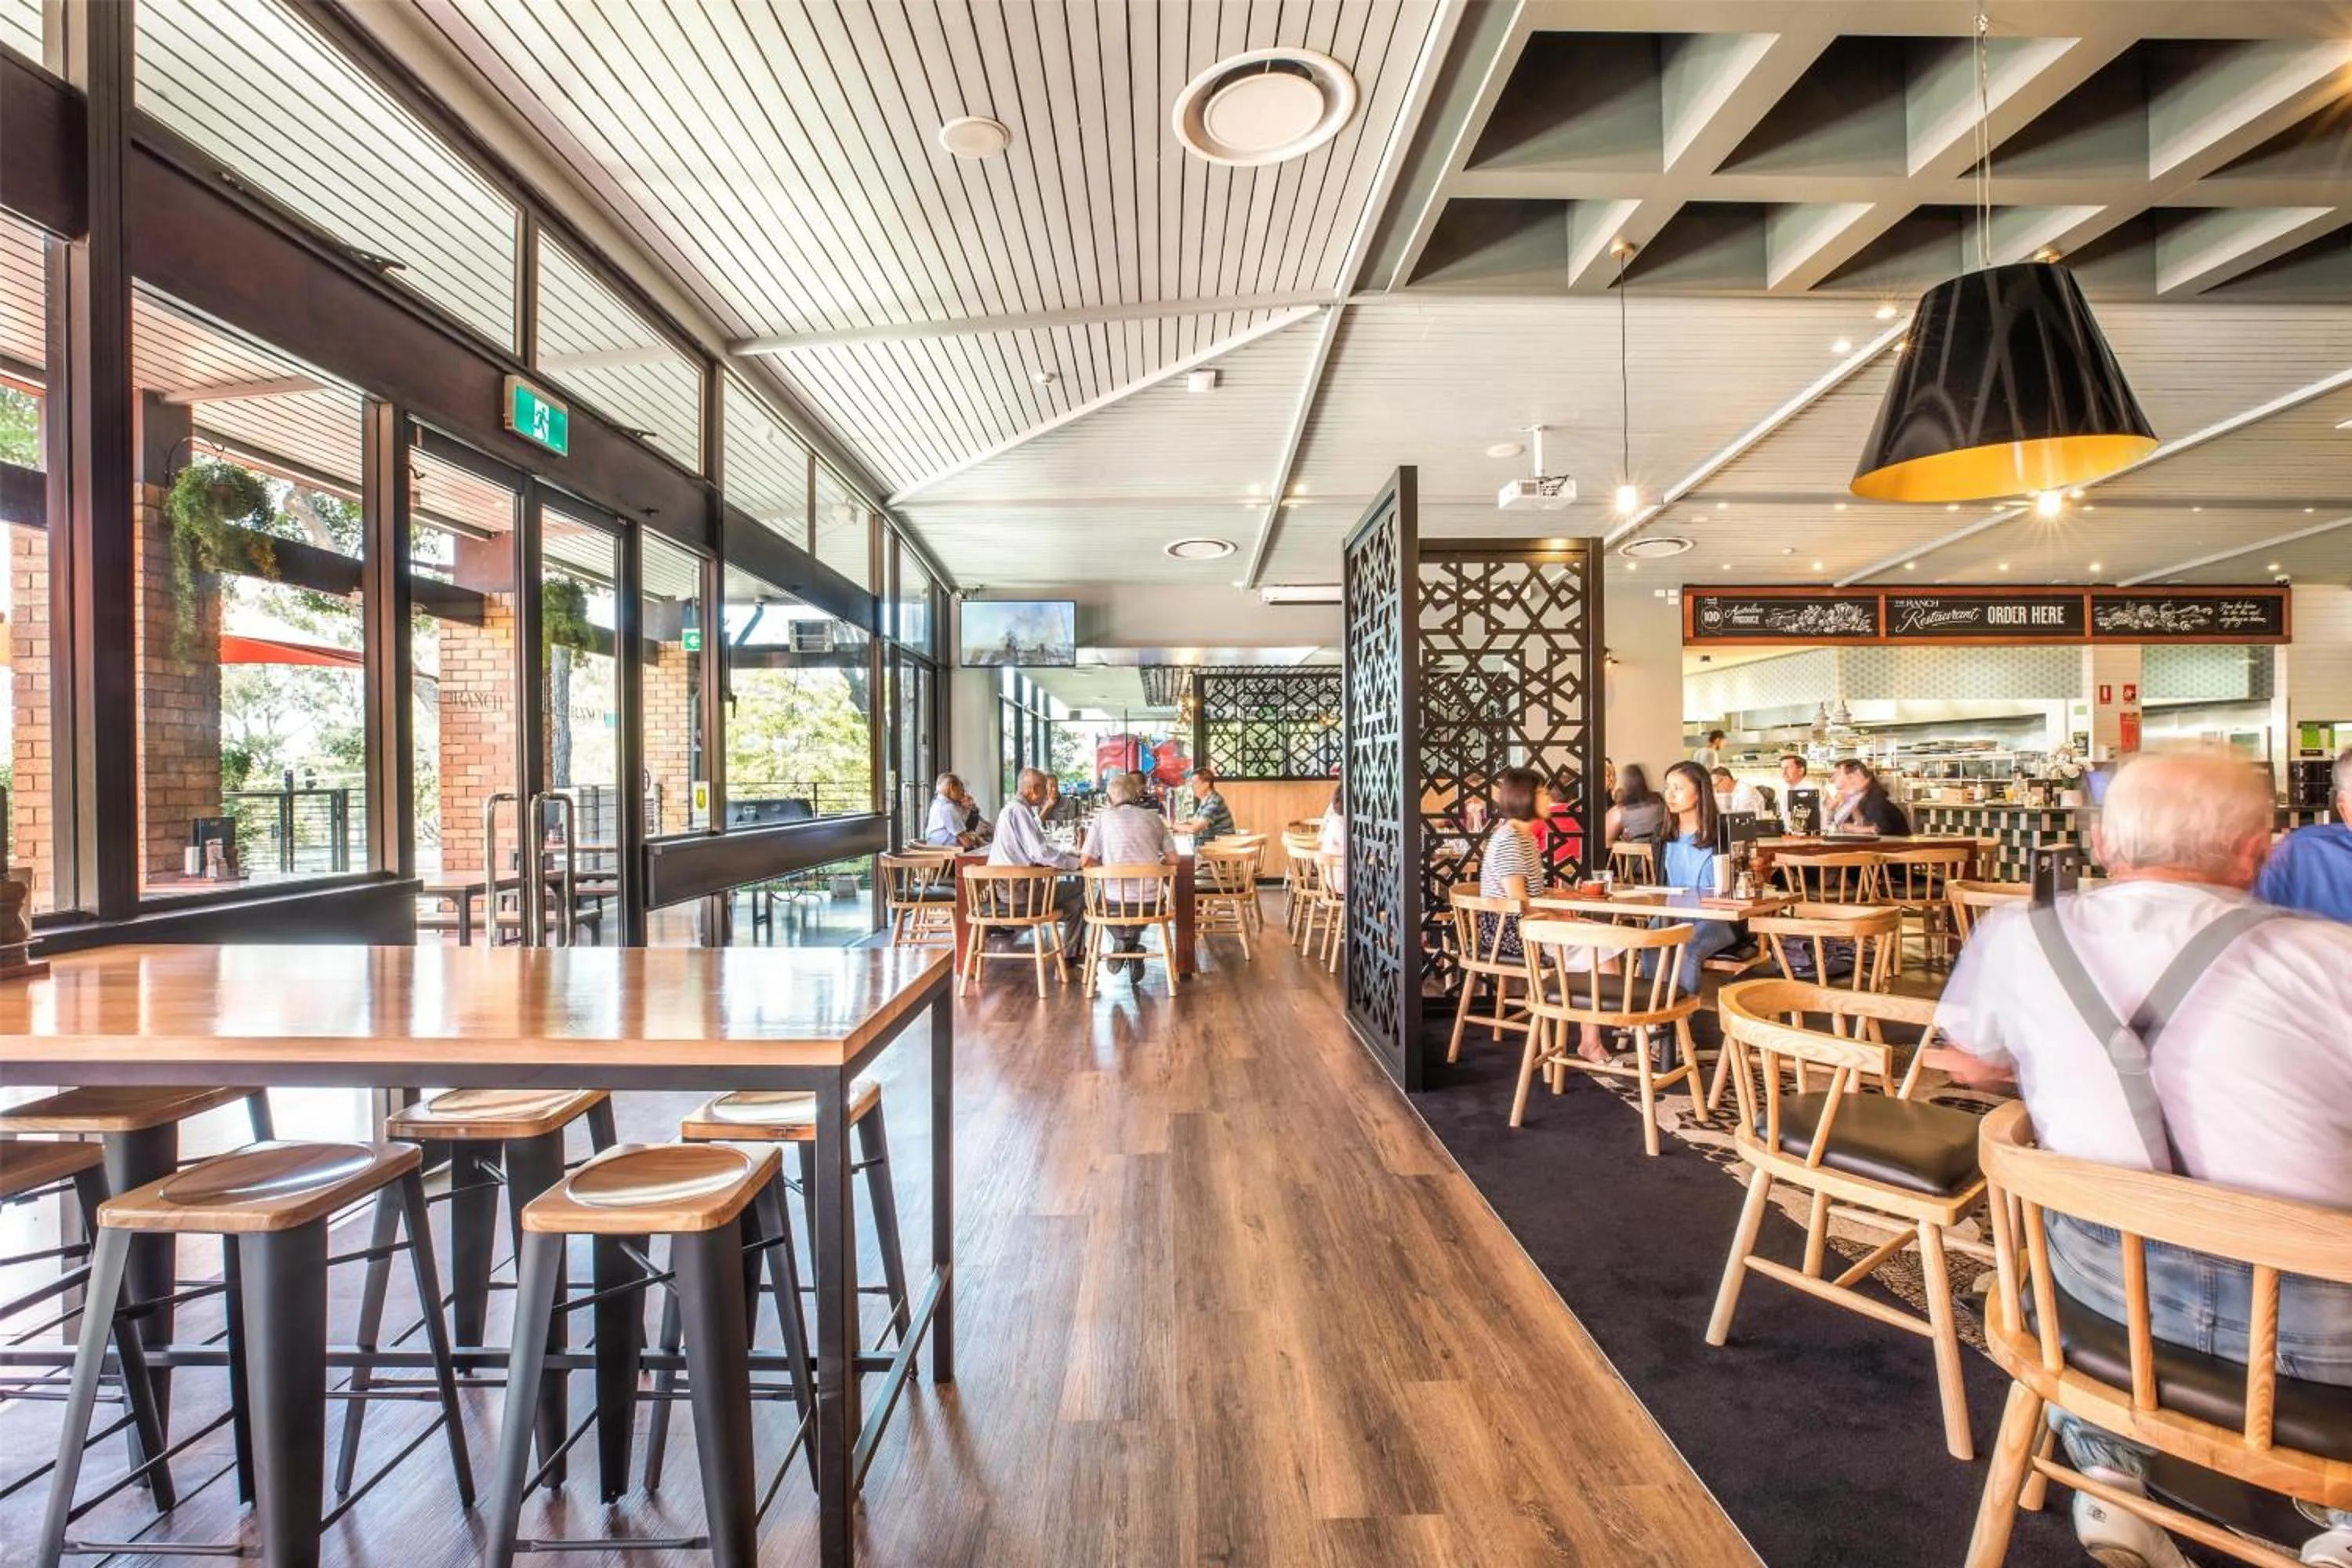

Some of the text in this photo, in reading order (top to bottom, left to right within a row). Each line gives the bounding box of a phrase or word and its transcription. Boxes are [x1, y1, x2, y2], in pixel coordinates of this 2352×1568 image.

[1906, 599, 1939, 608] RANCH
[1895, 607, 1982, 633] Restaurant
[1987, 606, 2064, 624] ORDER HERE
[453, 691, 503, 710] RANCH
